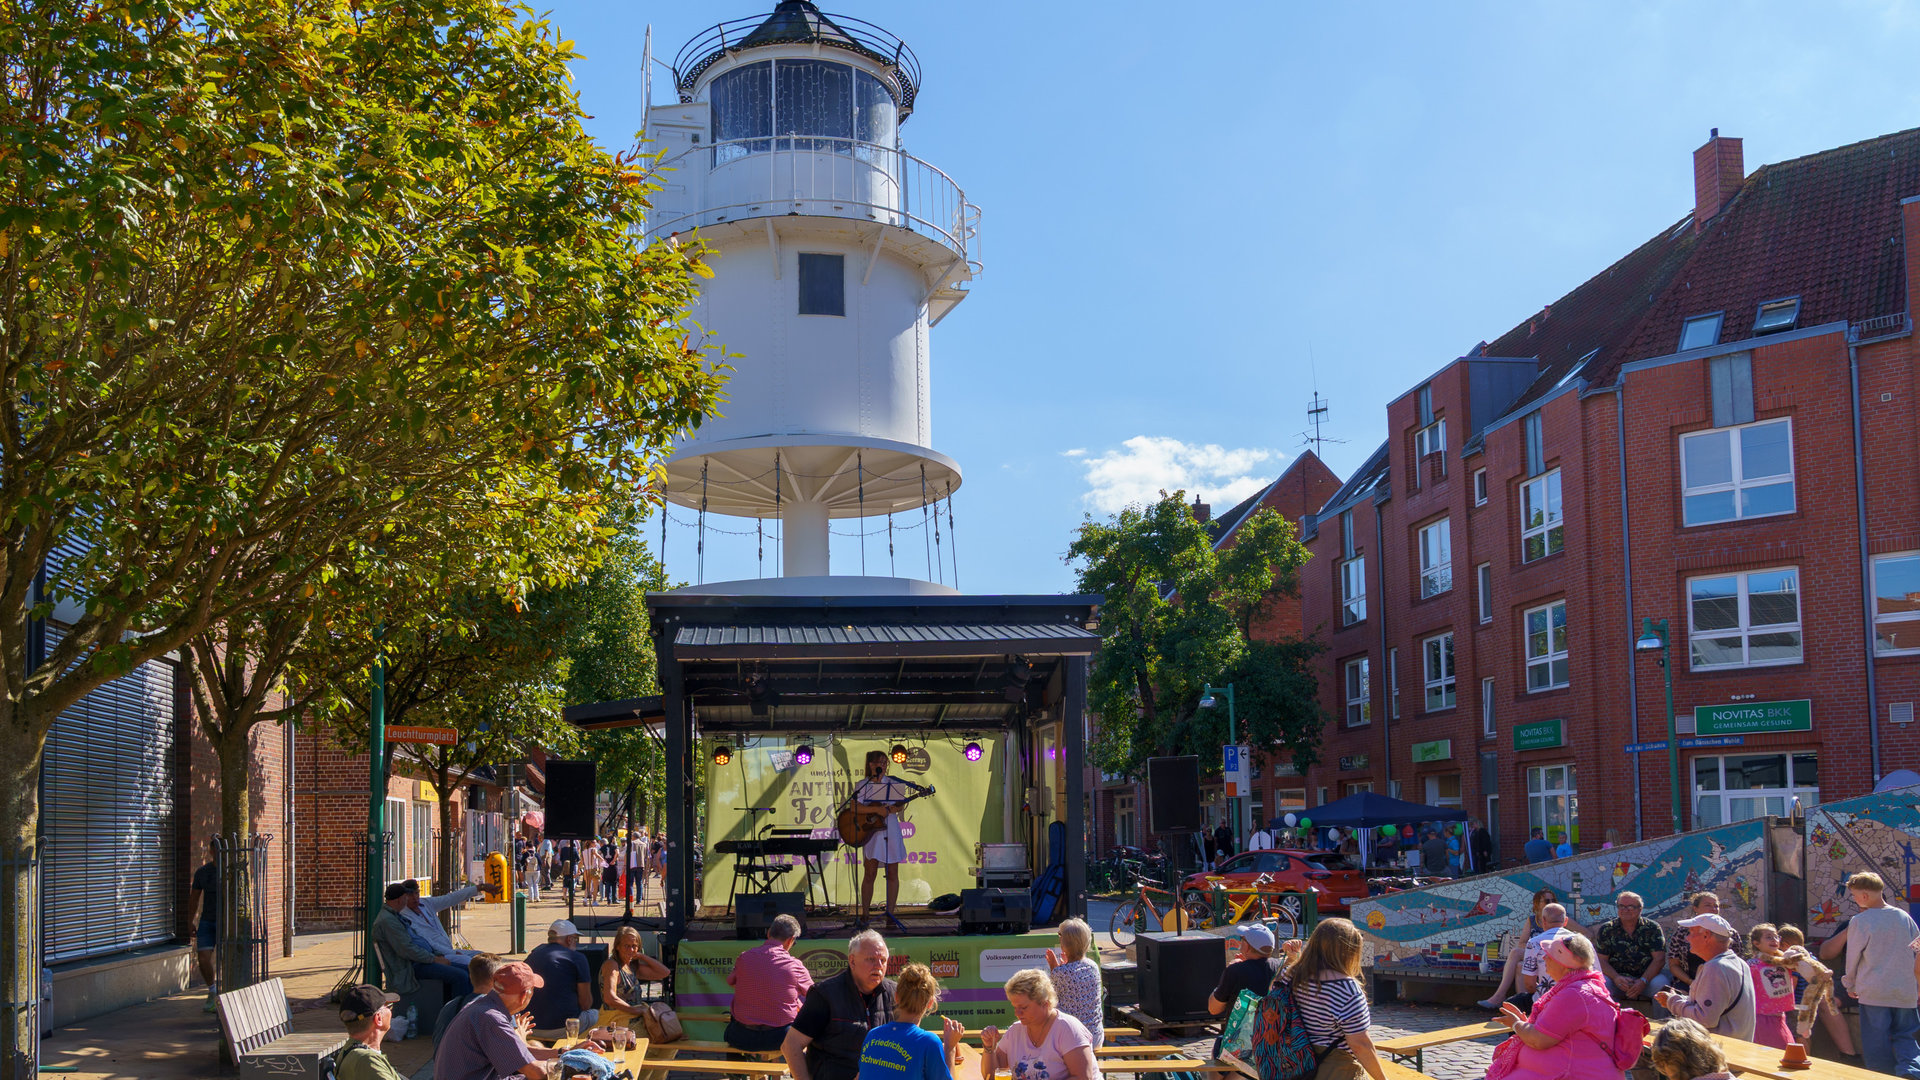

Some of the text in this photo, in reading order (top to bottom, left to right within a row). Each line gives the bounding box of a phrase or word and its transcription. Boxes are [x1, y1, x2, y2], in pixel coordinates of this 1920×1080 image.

[1712, 707, 1792, 721] NOVITAS BKK
[1713, 719, 1792, 729] GEMEINSAM GESUND
[387, 728, 454, 743] Leuchtturmplatz
[1520, 727, 1543, 737] NOVITAS
[1228, 749, 1235, 760] P
[930, 950, 960, 961] kwilt
[678, 957, 733, 966] ADEMACHER
[678, 967, 733, 975] OMPOSITES
[930, 962, 959, 977] factory
[870, 1038, 912, 1062] Friedrichsort
[860, 1054, 906, 1072] Schwimmen
